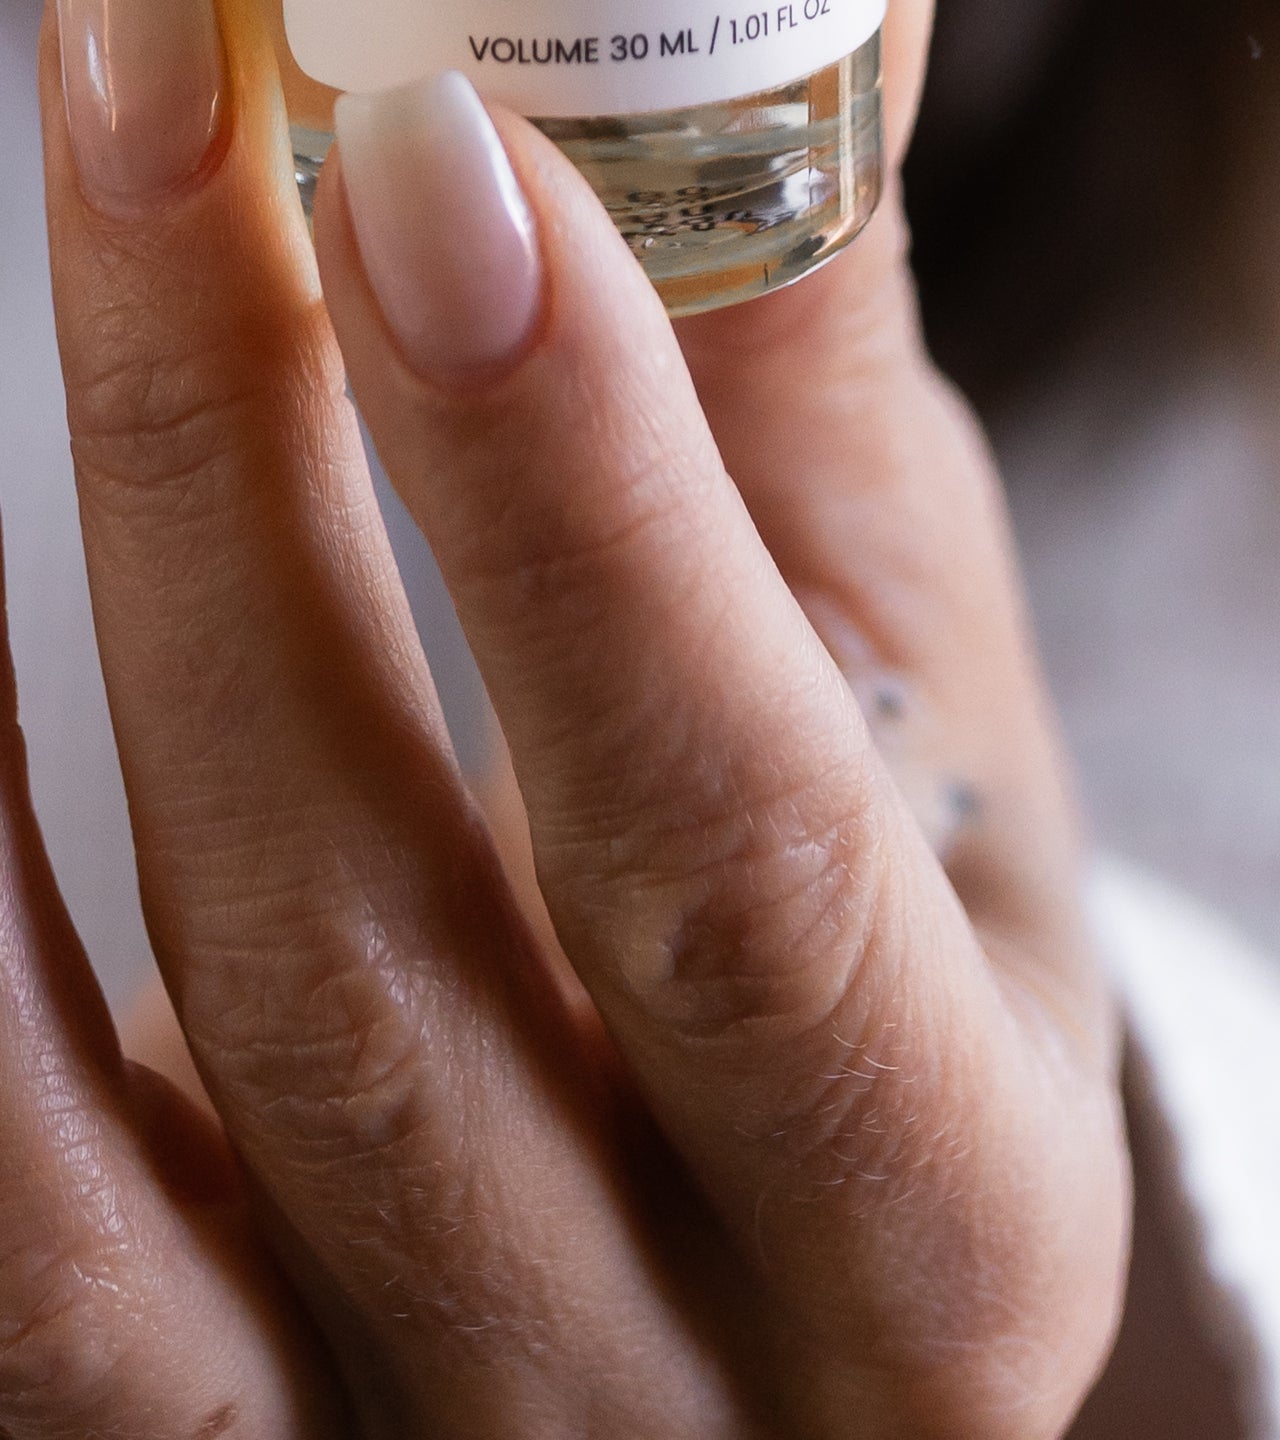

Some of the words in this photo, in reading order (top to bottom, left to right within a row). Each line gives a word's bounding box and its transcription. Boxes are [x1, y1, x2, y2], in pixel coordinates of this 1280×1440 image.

[468, 34, 599, 65] VOLUME
[609, 33, 650, 63] 30
[659, 28, 700, 58] ML
[708, 14, 721, 56] /
[728, 11, 770, 46] 1.01
[776, 4, 799, 33] FL
